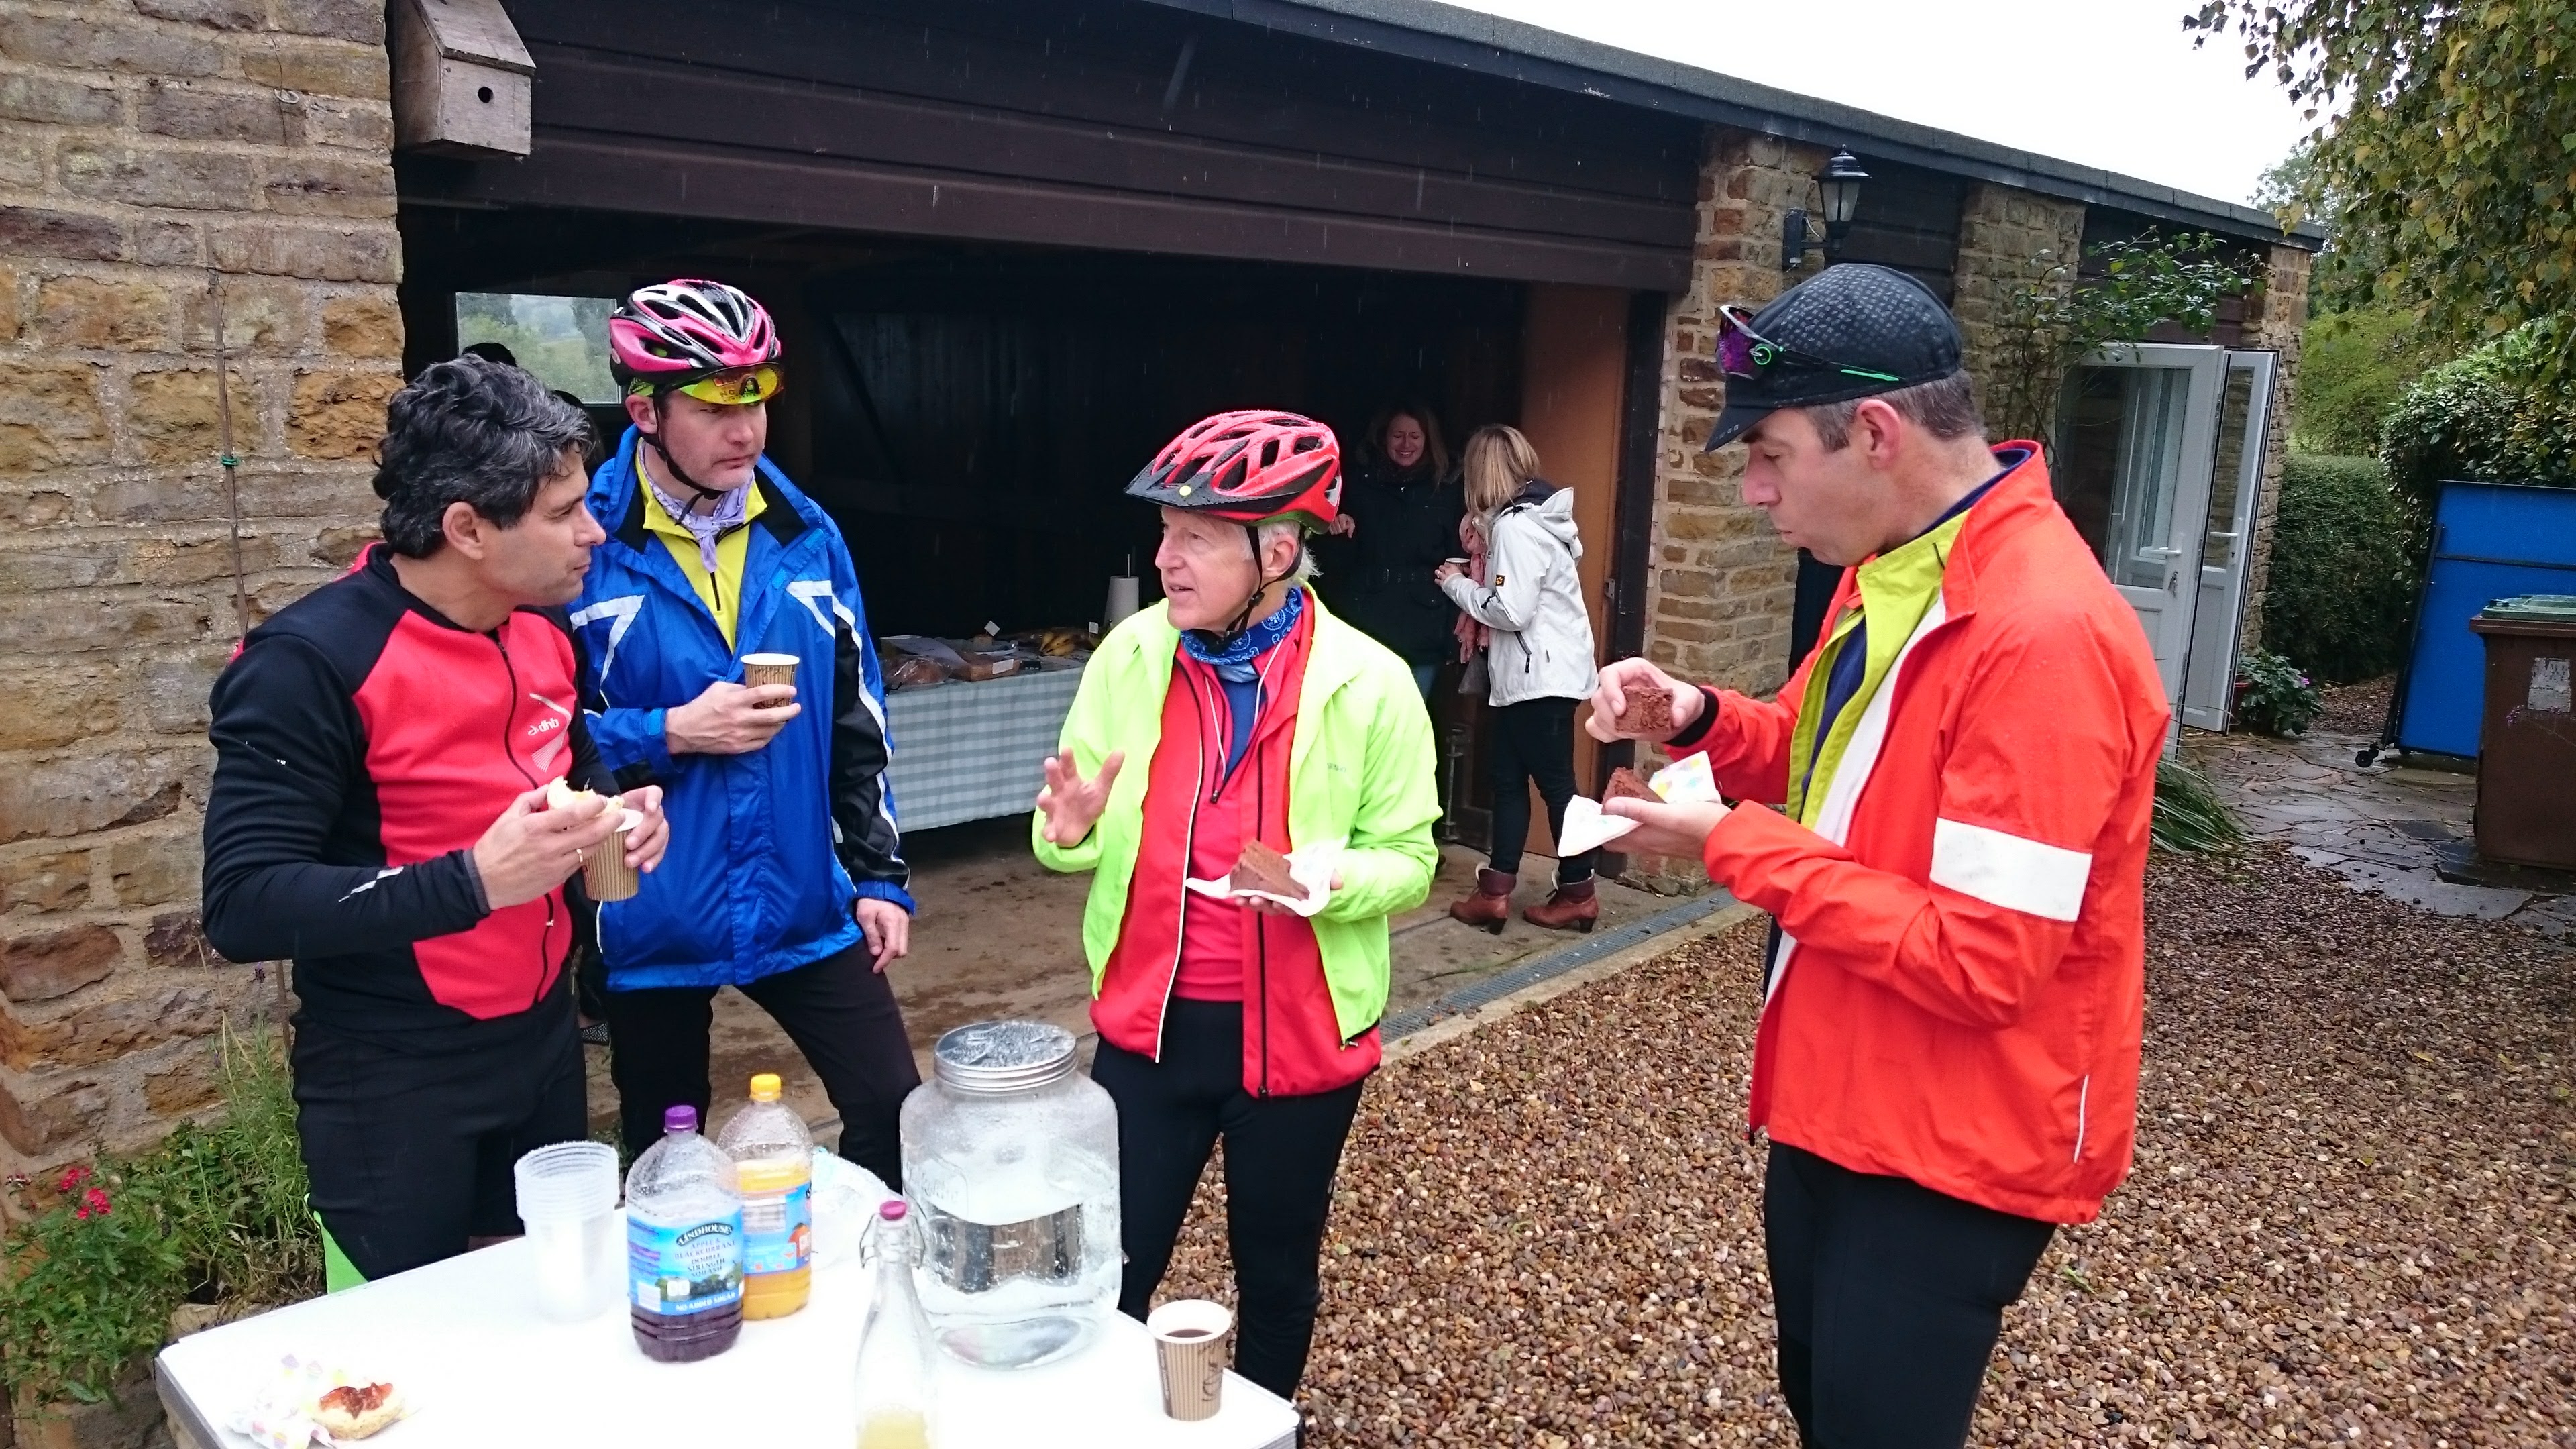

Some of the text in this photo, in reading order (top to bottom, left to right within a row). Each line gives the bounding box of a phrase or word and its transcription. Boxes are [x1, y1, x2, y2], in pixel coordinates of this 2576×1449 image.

[538, 717, 560, 733] dhb
[678, 1224, 732, 1246] LINDHOUSE
[674, 1240, 735, 1259] BLACKCURRANT
[691, 1239, 712, 1249] APPLE
[688, 1258, 725, 1271] STRENGTH
[691, 1253, 720, 1265] DOUBLE
[691, 1266, 722, 1277] SQUASH
[676, 1291, 736, 1311] NO ADDED SUGAR
